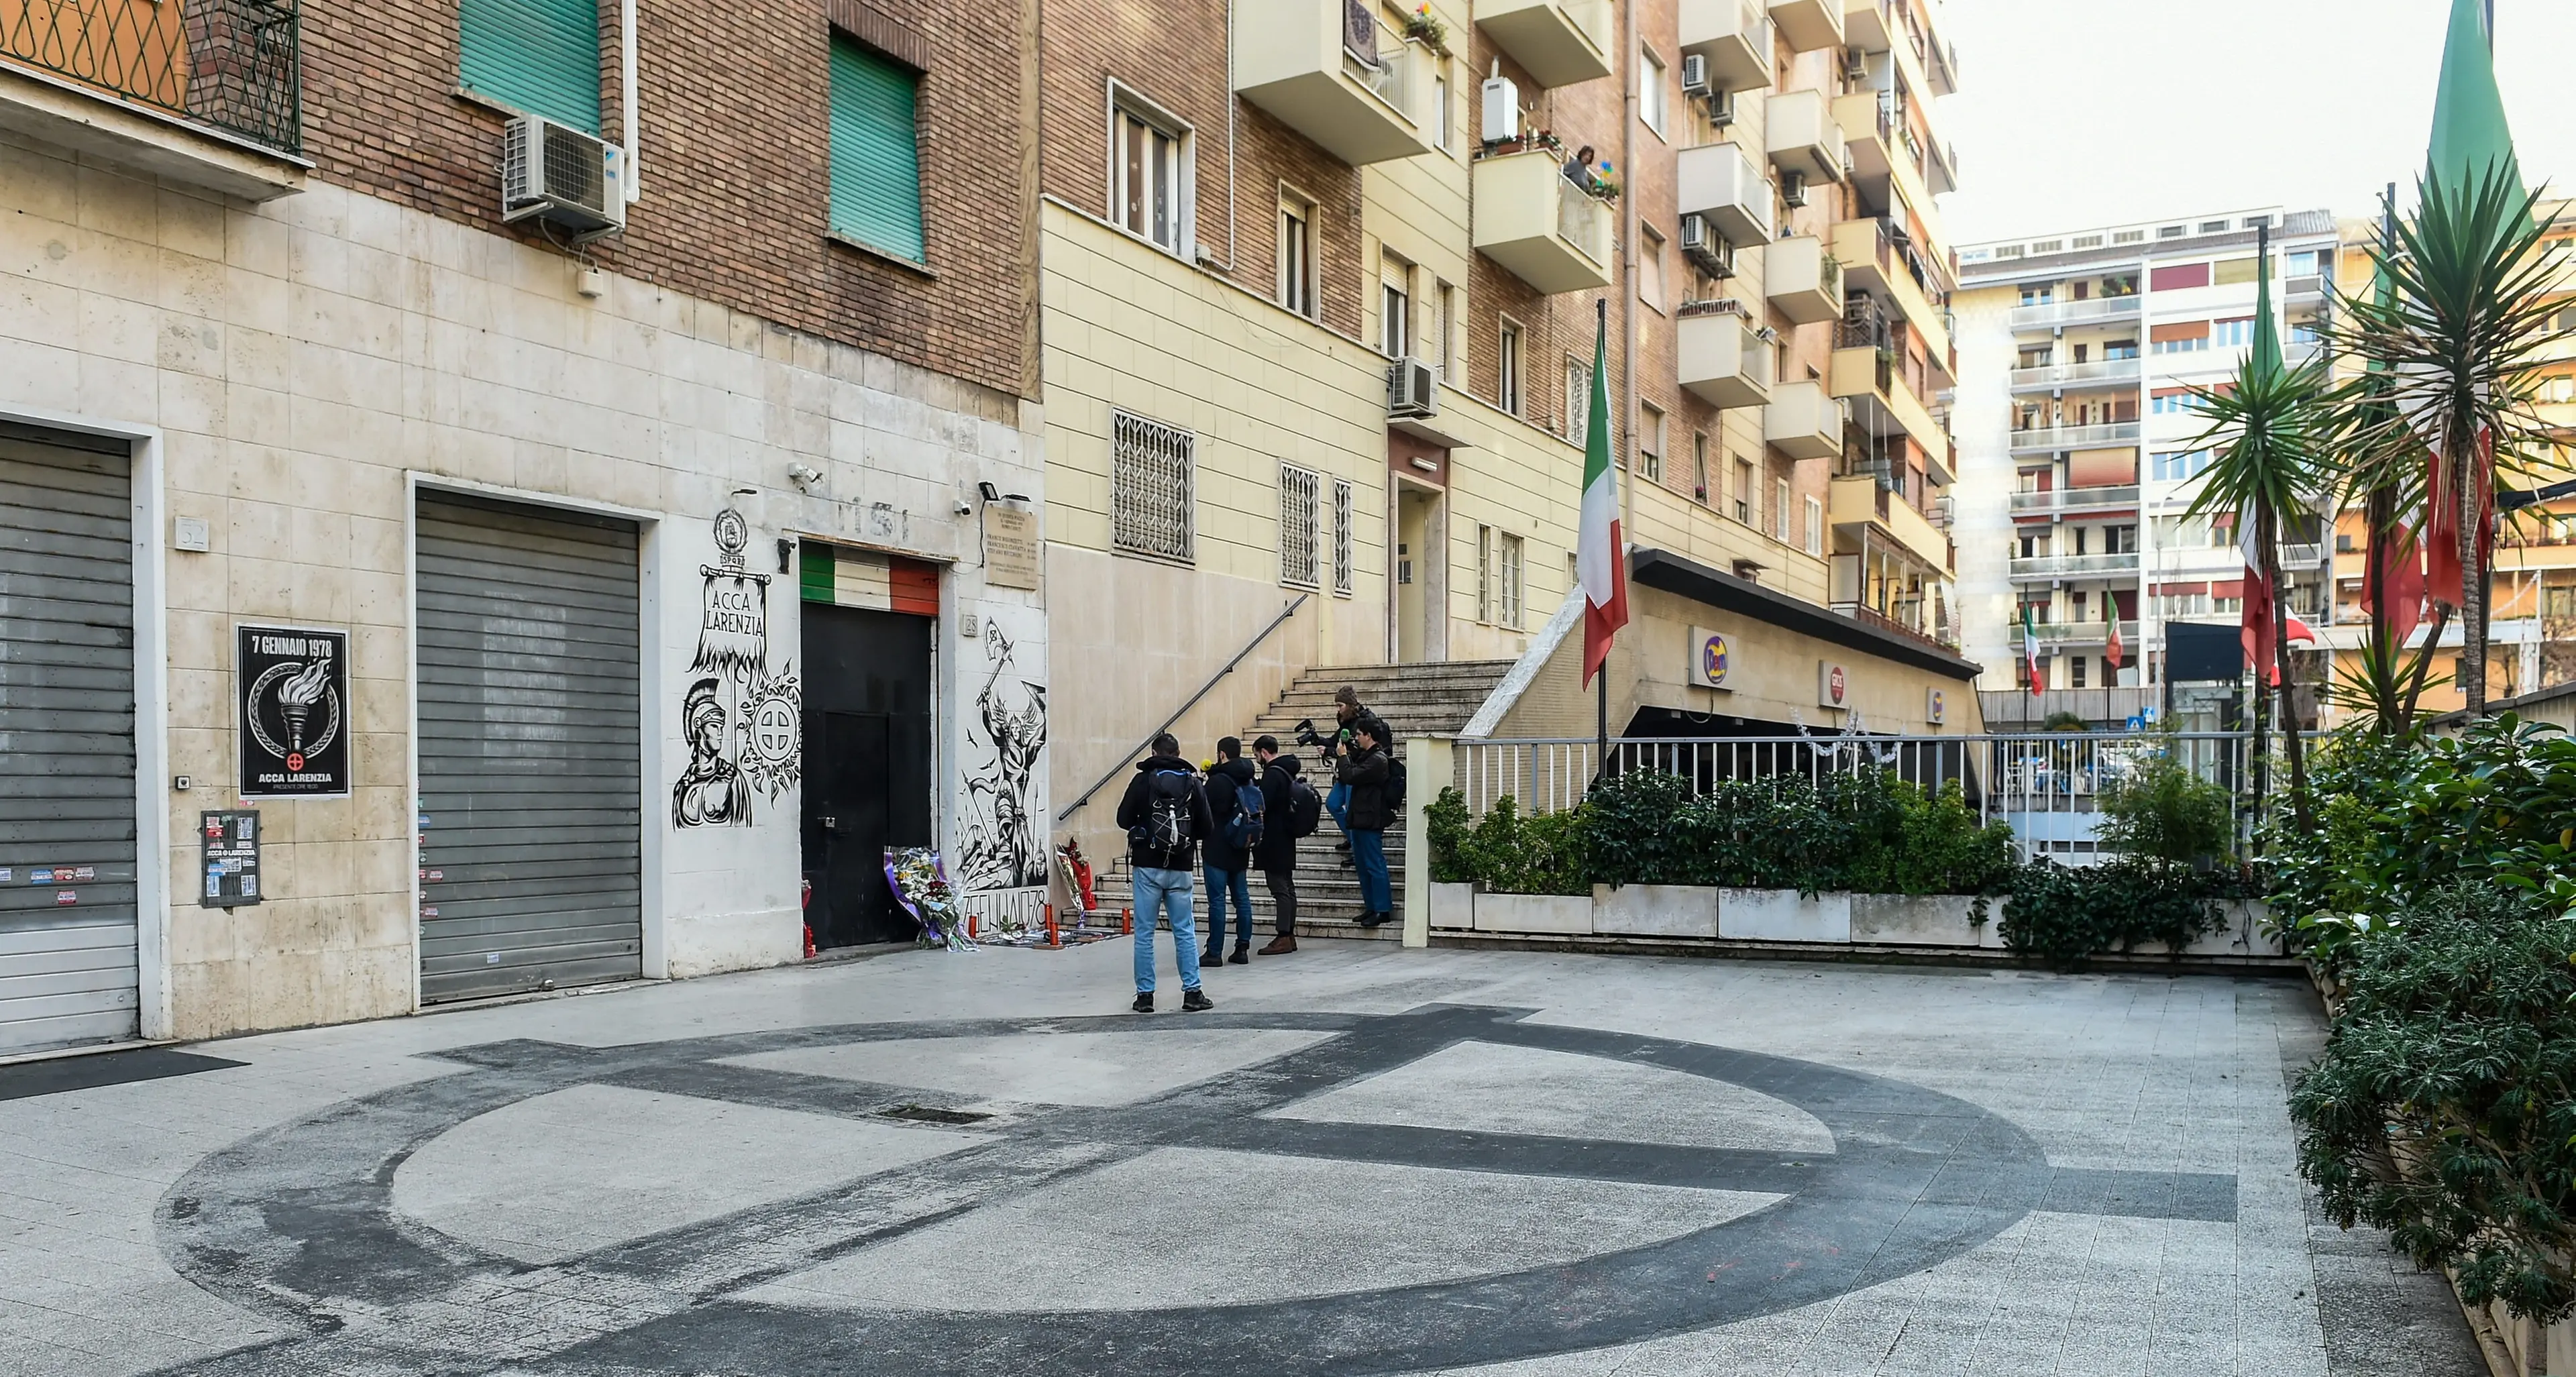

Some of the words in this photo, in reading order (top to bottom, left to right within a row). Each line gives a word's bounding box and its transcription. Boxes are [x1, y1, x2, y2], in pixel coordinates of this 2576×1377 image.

[181, 524, 203, 545] 52
[723, 557, 741, 566] SPQR
[712, 590, 750, 611] ACCA
[706, 610, 763, 637] LARENZIA
[252, 636, 260, 654] 7
[262, 636, 307, 657] GENNAIO
[309, 639, 332, 657] 1978
[258, 773, 285, 783] ACCA
[287, 773, 332, 783] LARENZIA
